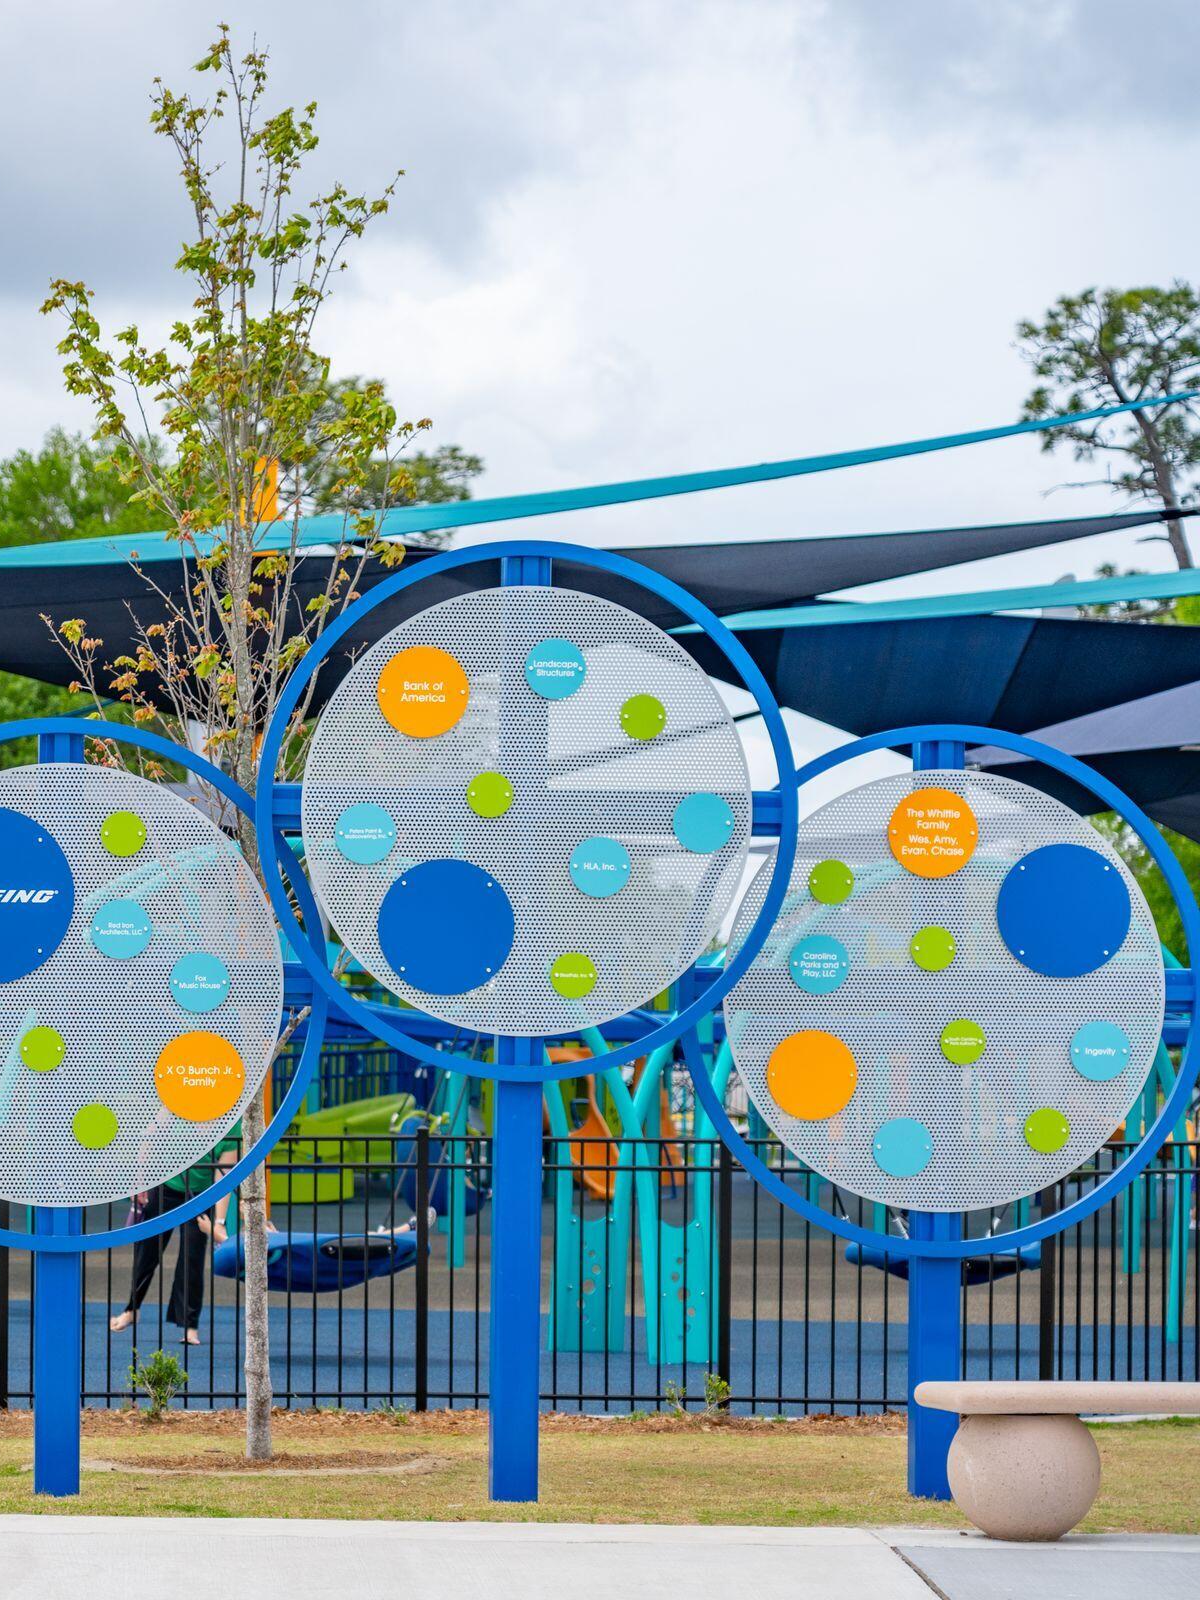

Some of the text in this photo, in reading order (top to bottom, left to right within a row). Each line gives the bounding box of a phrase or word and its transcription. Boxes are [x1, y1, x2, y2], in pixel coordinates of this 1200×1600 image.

[533, 659, 579, 669] Landscape
[536, 668, 576, 677] Structures
[403, 681, 444, 691] Bank of
[400, 692, 446, 703] America
[906, 807, 925, 818] The
[916, 820, 951, 831] Family
[933, 834, 959, 845] Amy,
[901, 845, 965, 856] Evan, Chase
[583, 862, 617, 871] HLA, Inc.
[802, 952, 838, 960] Carolina
[800, 960, 840, 969] Parks and
[194, 974, 207, 982] Fox
[822, 969, 837, 978] LLC
[178, 981, 221, 989] Music House
[1084, 1047, 1117, 1057] Ingevity
[166, 1065, 234, 1075] X O Bunch Jr.
[182, 1077, 216, 1088] Family
